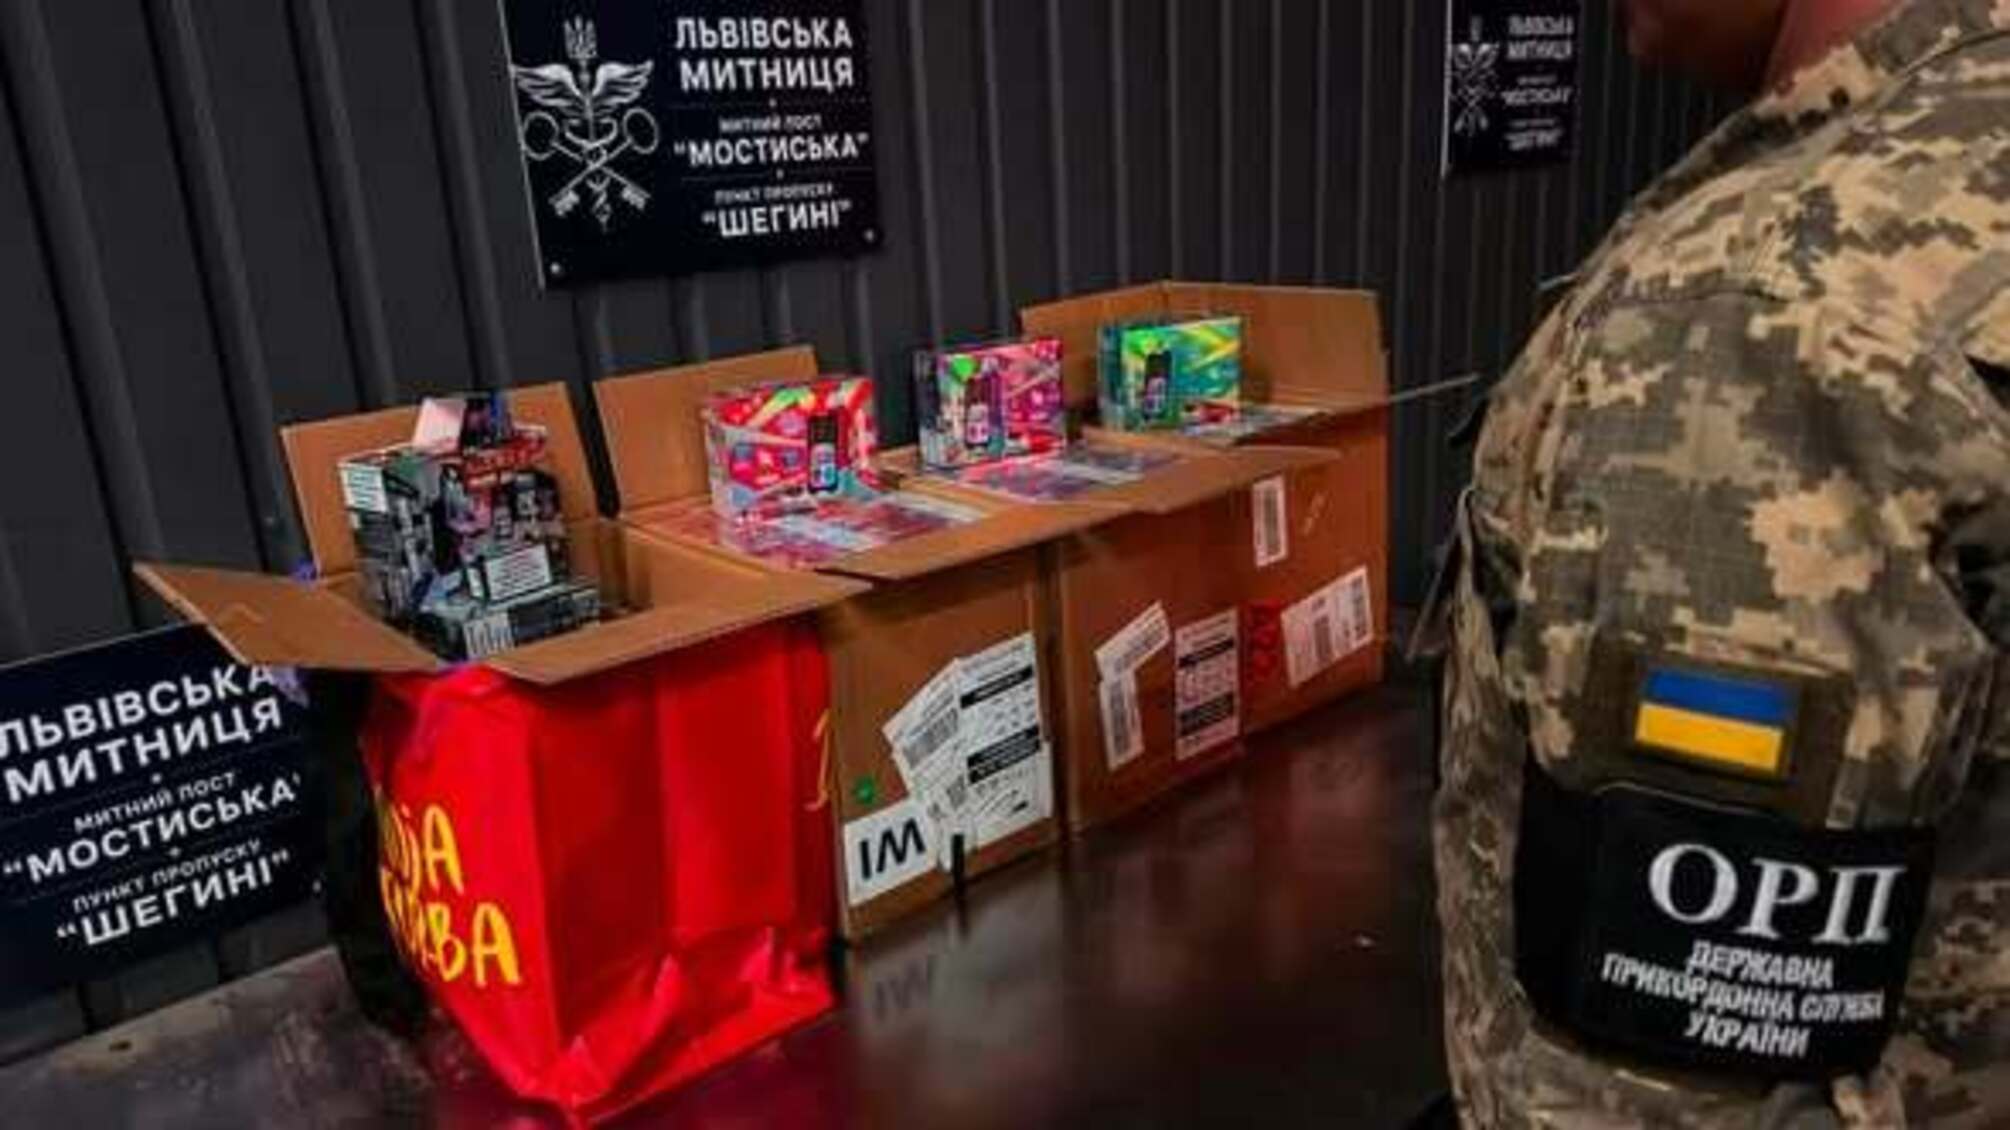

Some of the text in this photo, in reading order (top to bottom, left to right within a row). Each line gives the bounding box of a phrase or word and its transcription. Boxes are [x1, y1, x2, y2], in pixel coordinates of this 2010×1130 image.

[675, 16, 853, 50] ЛЬВІВСЬКА
[679, 56, 854, 93] МИТНИЦЯ
[0, 664, 275, 758] ЛЬВІВСЬКА
[3, 696, 282, 804] МИТНИЦЯ
[73, 772, 236, 832] МИТНИЙ ПОСТ
[56, 849, 290, 945] “ШЕГИНІ”
[72, 838, 260, 913] ПУНКТ ПРОПУСКУ
[1647, 843, 1907, 946] ОРП
[1601, 952, 1796, 1022] ПРИКОРДОННА
[1685, 940, 1835, 990] ДЕРЖАВНА
[1683, 1011, 1811, 1059] УКРАЇНИ
